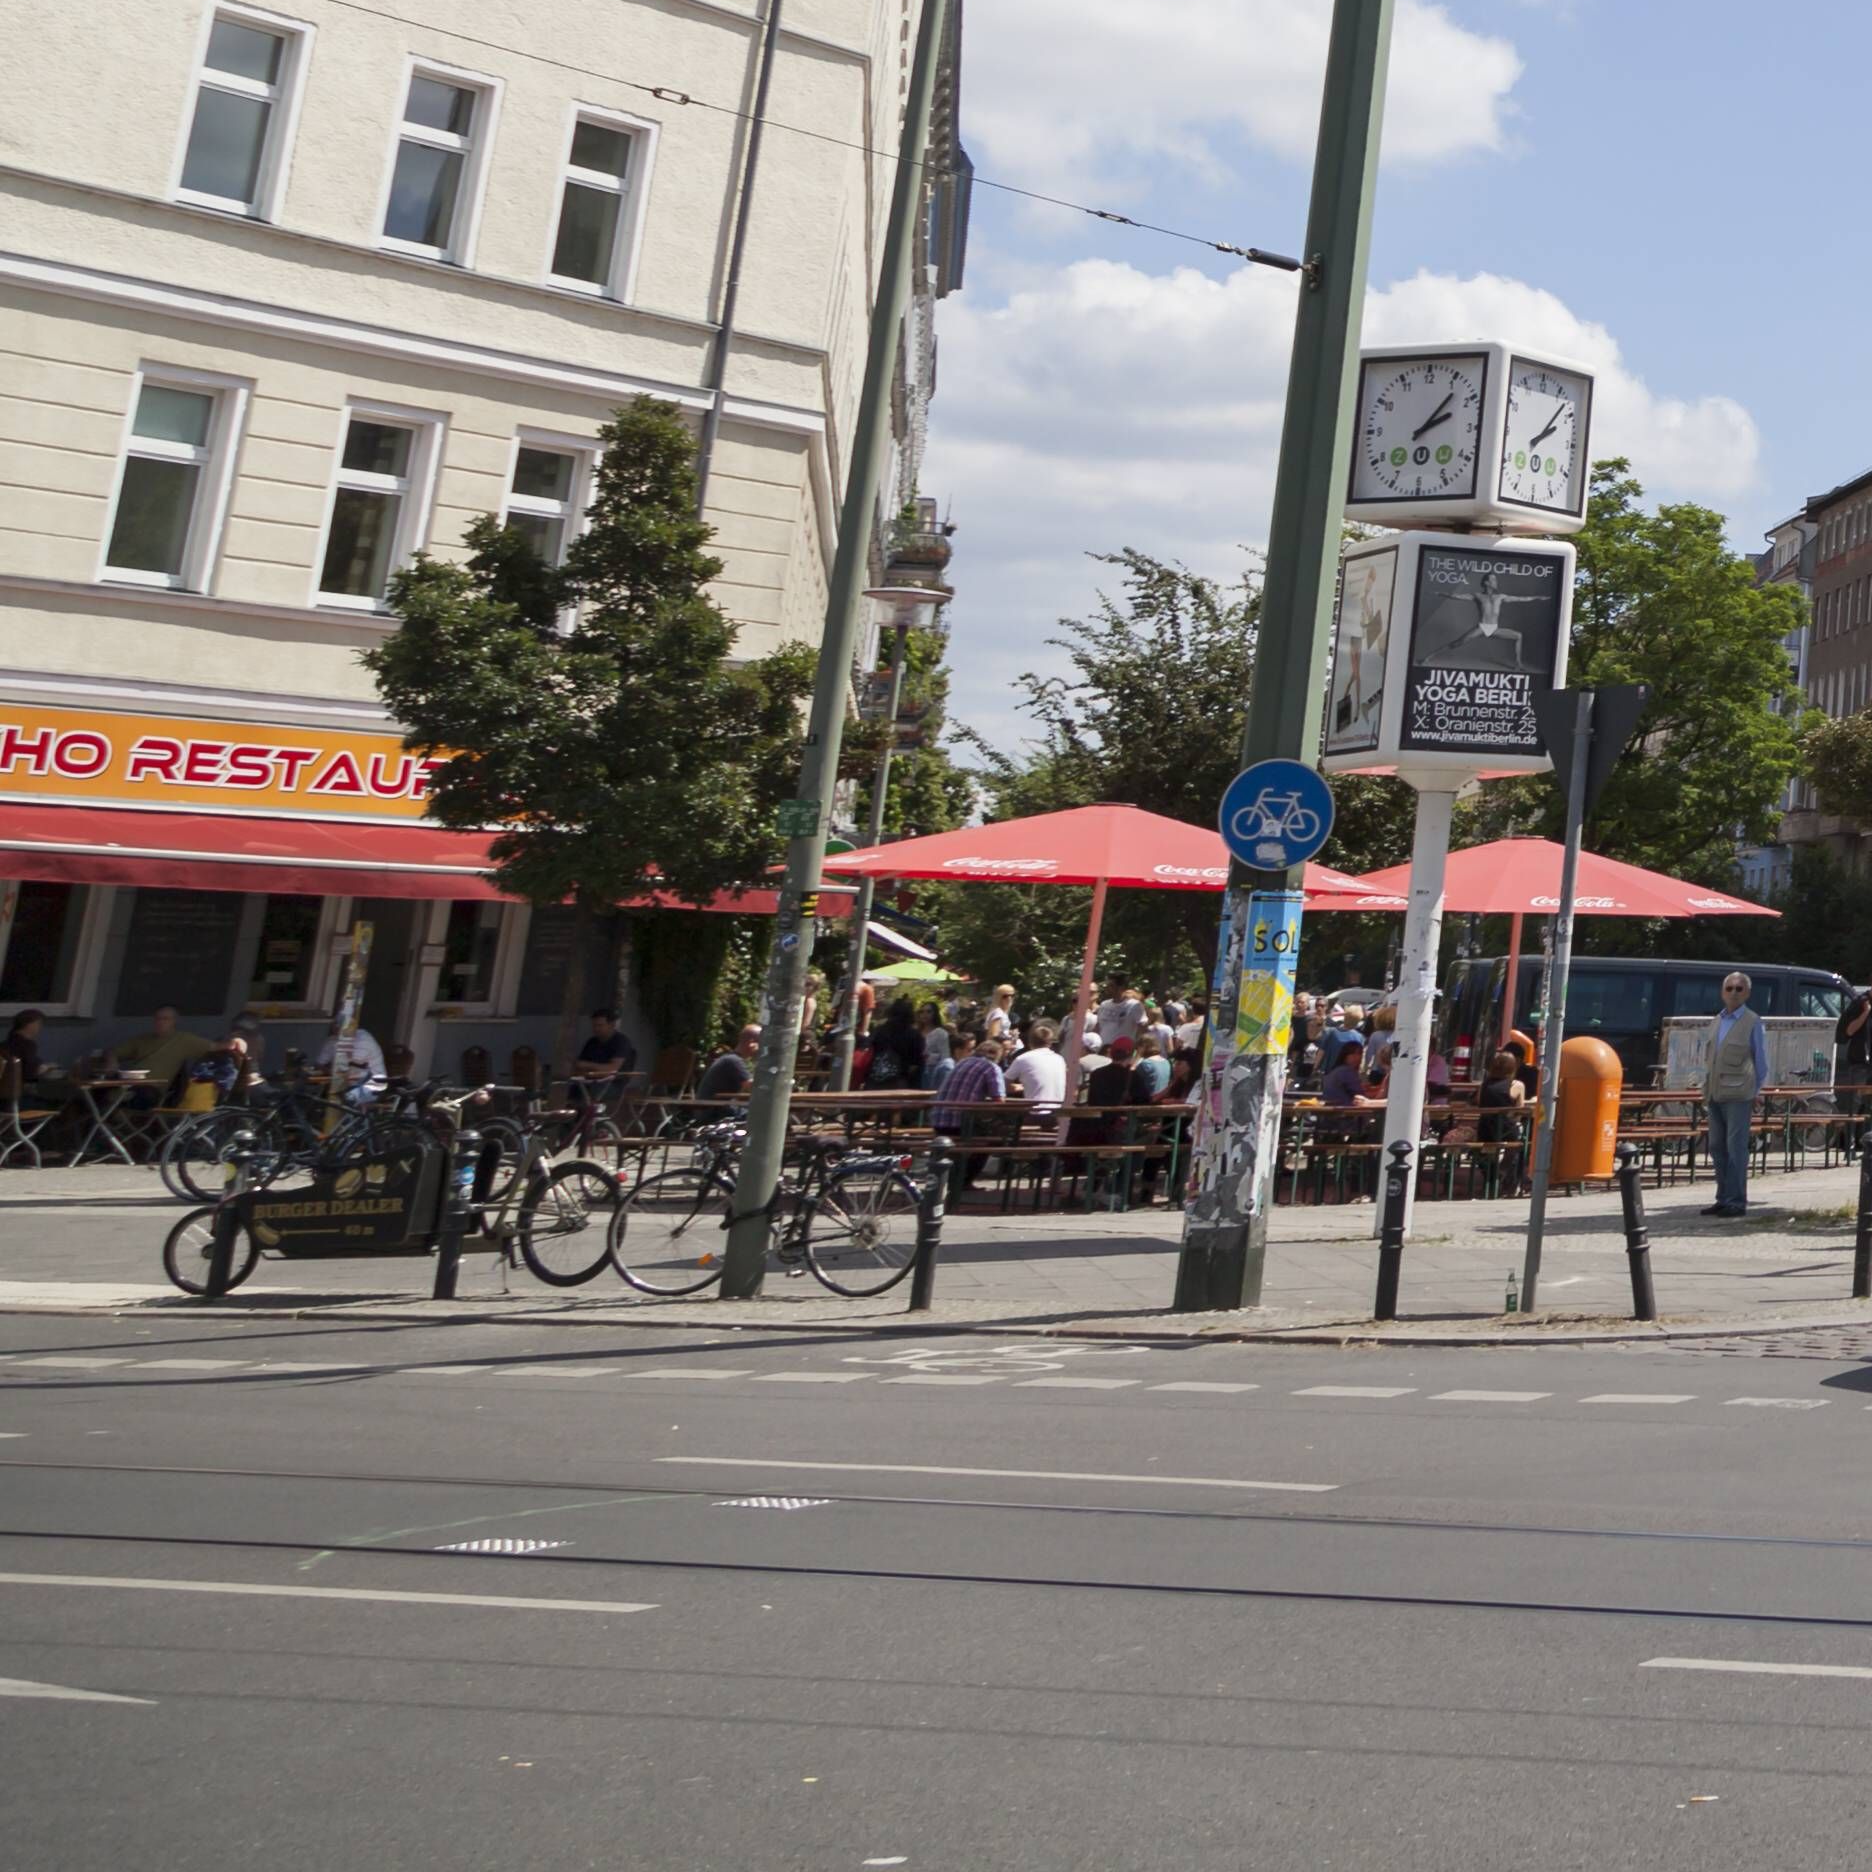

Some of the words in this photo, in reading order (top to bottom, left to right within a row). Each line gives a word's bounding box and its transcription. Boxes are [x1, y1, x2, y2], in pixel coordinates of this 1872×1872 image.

[1403, 382, 1412, 392] 11
[1425, 374, 1435, 384] 12
[1384, 401, 1394, 411] 10
[1463, 397, 1469, 408] 2
[1429, 557, 1455, 570] THE
[1457, 560, 1491, 573] WILD
[1493, 562, 1532, 575] CHILD
[1534, 565, 1553, 577] OF
[1428, 570, 1468, 584] YOGA
[1424, 669, 1530, 689] JIVAMUKTI
[1415, 685, 1470, 703] YOGA
[1412, 701, 1431, 715] M:
[1434, 702, 1518, 720] Brunnenstr.
[1414, 715, 1430, 729] X:
[1435, 716, 1514, 733] Oranienstr.
[1518, 721, 1537, 734] 25
[1411, 730, 1538, 745] www.jivamuktiberlin.de
[253, 1201, 327, 1219] BURGER
[330, 1198, 403, 1216] DEALER
